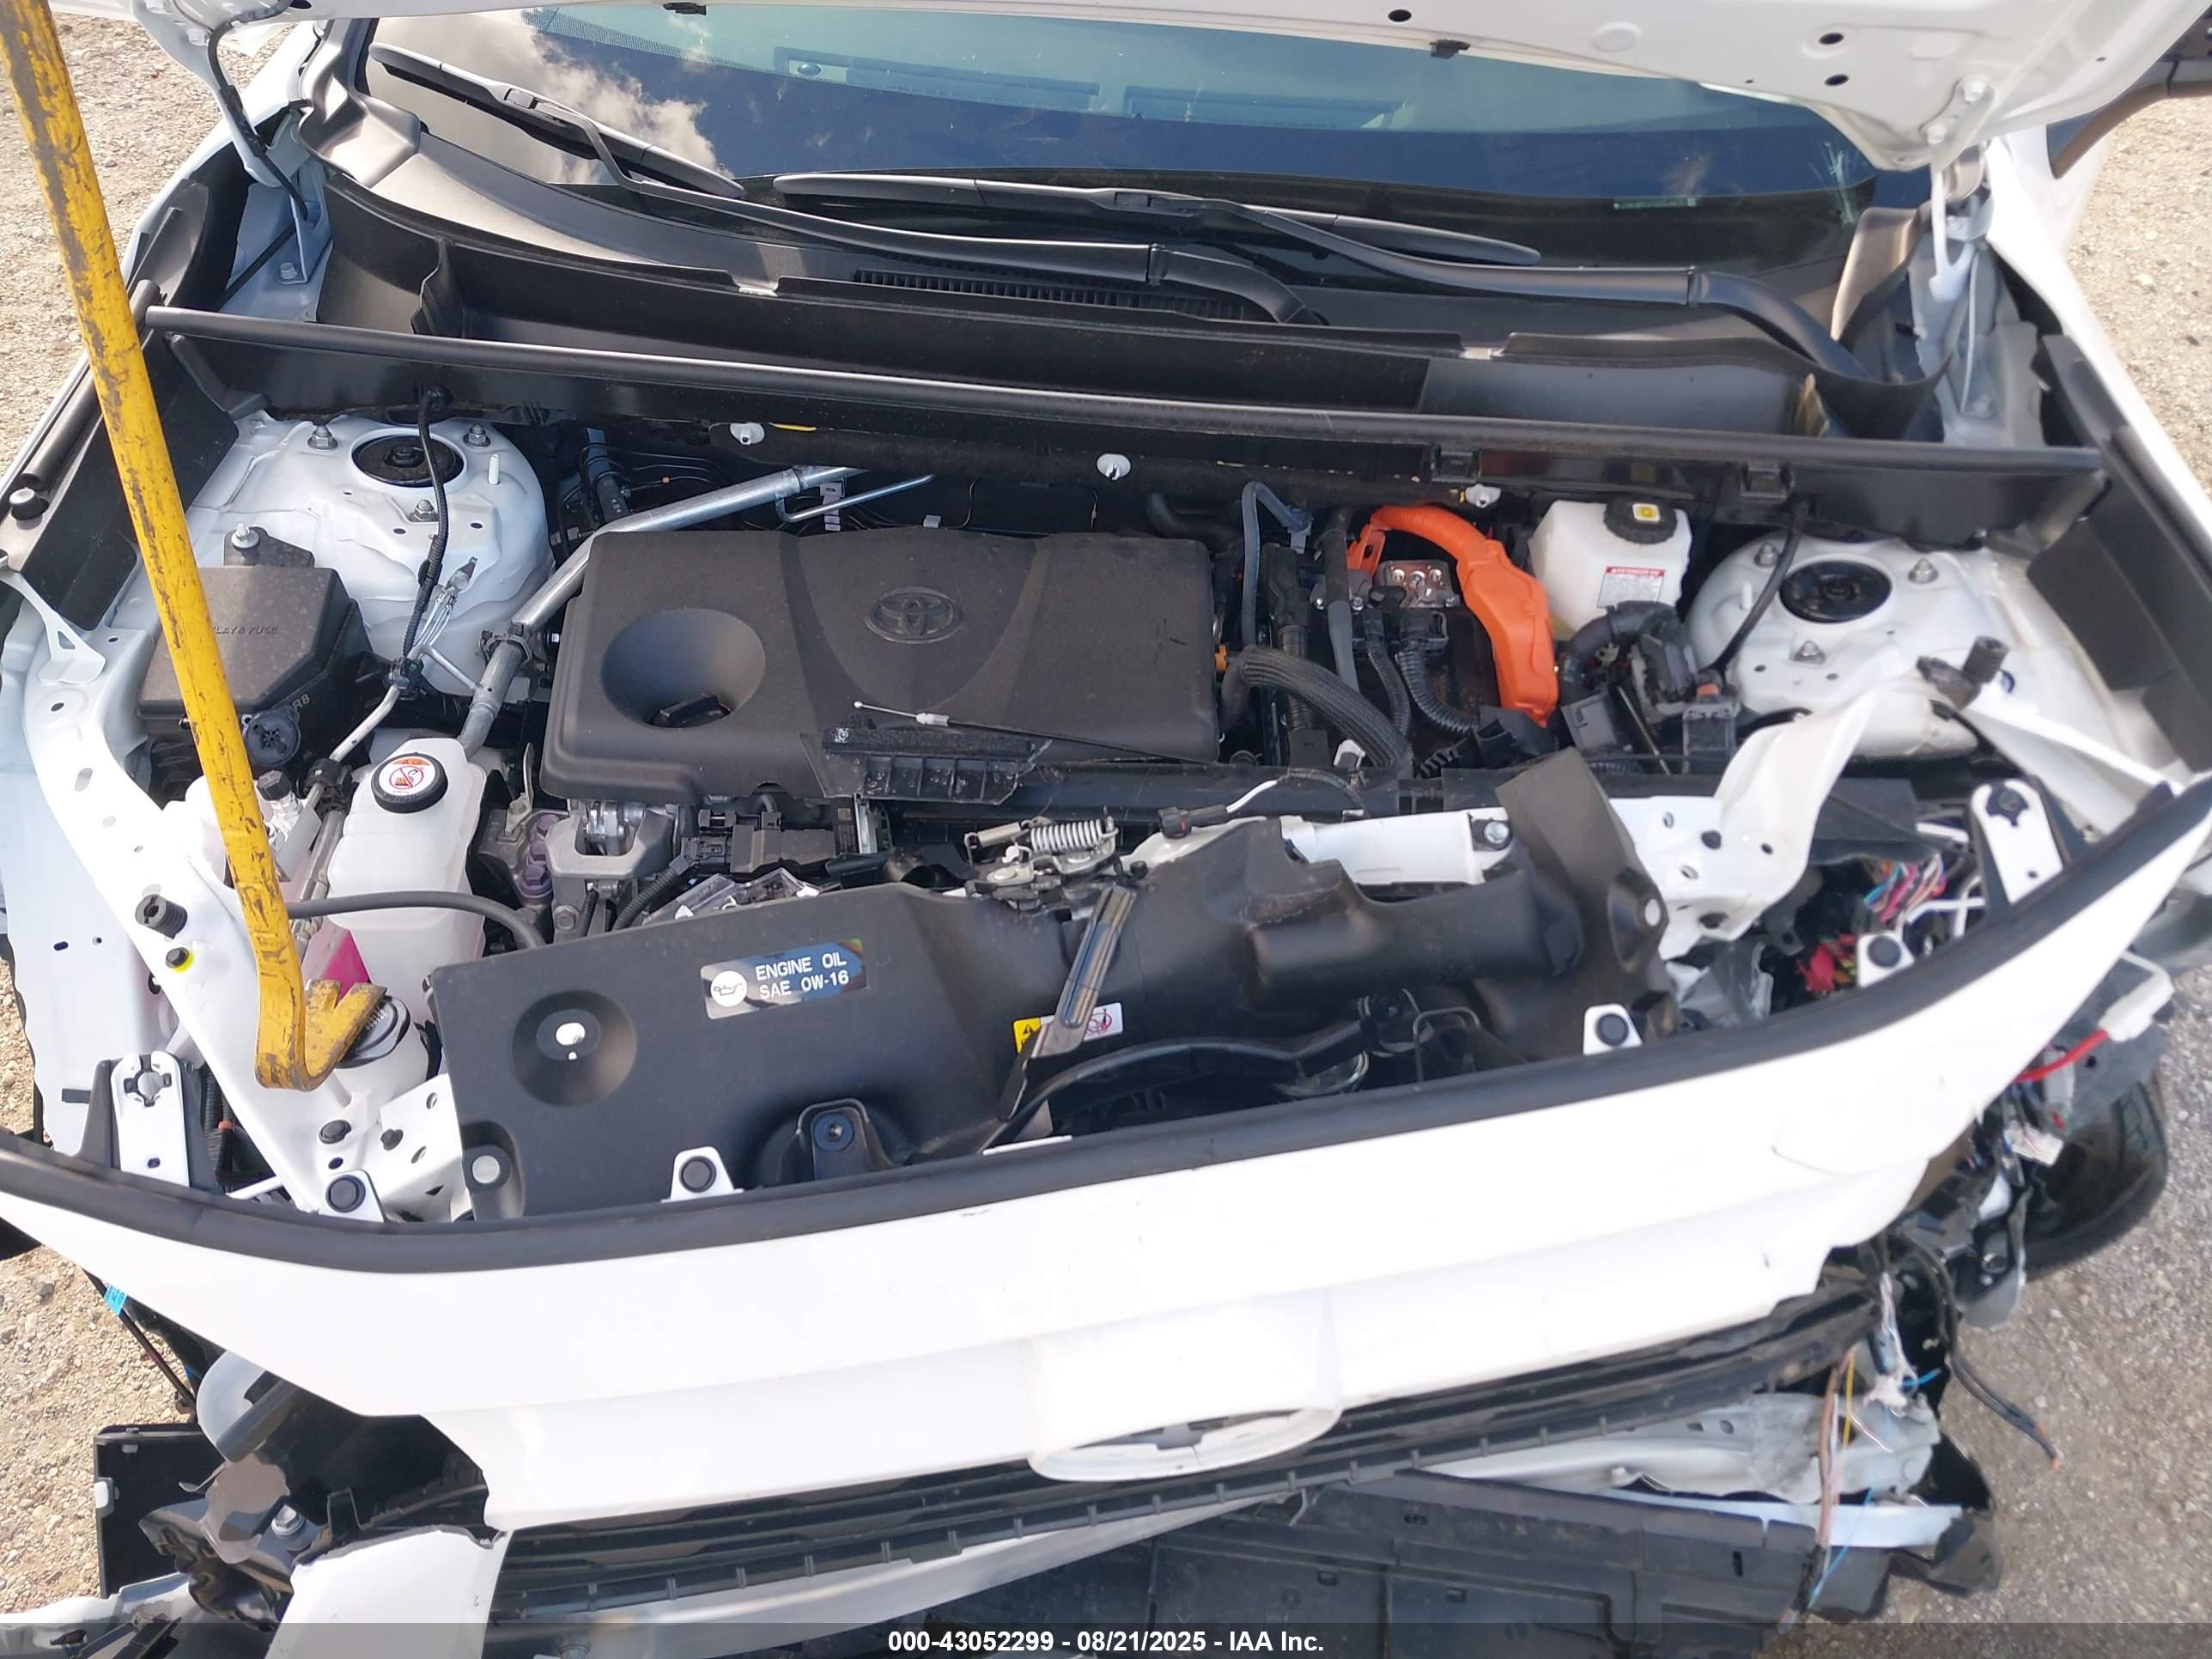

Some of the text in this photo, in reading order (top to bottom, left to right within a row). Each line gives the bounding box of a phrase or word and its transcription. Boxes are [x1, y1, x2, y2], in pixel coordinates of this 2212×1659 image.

[248, 625, 279, 635] FUSE
[755, 951, 848, 981] ENGINE OIL
[759, 969, 850, 1000] SAE 0W-16
